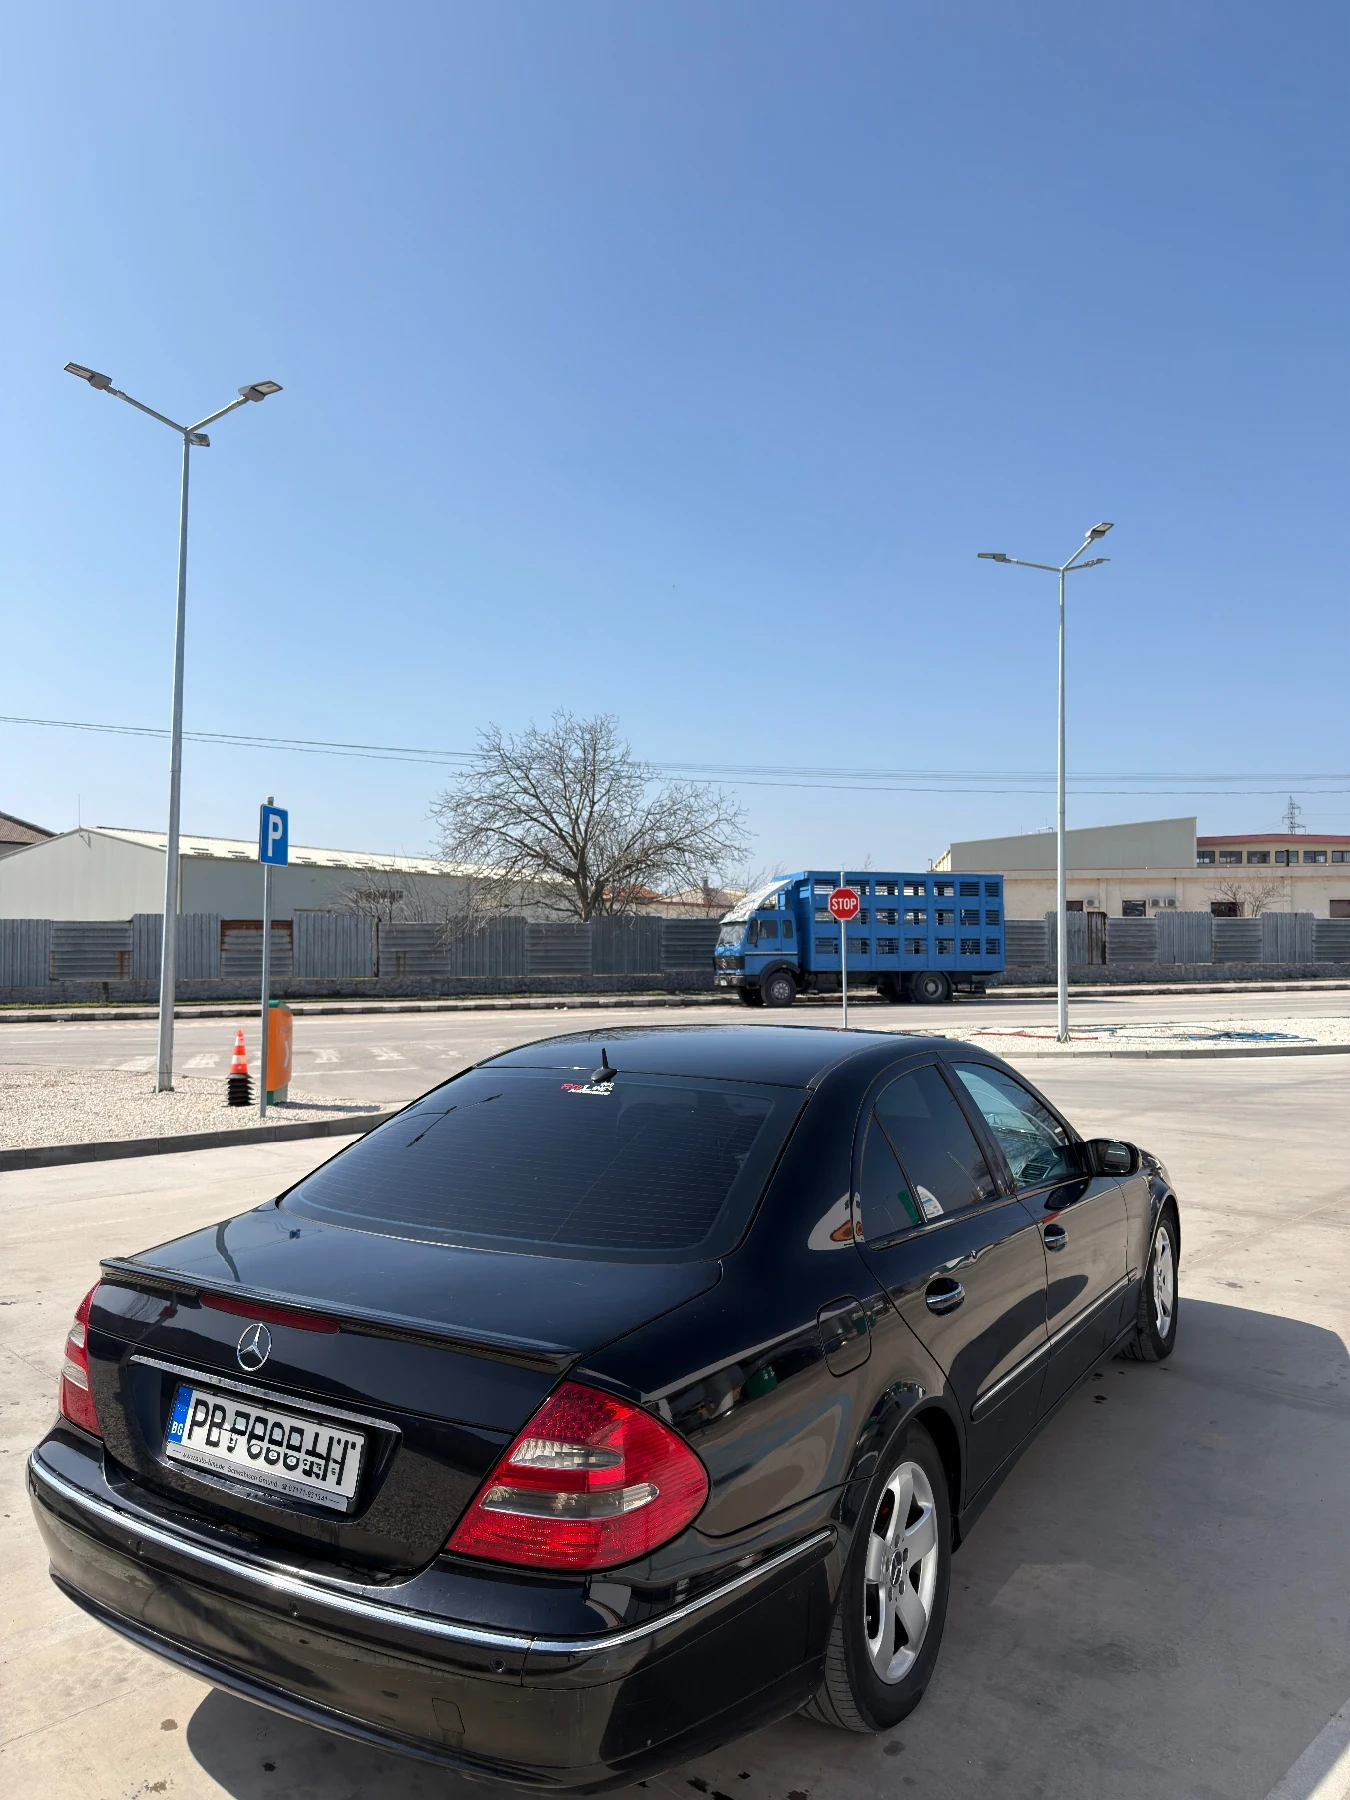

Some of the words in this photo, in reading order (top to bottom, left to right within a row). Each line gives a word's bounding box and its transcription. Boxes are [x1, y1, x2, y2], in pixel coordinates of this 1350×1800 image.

[267, 813, 283, 857] P
[831, 898, 857, 910] STOP
[171, 1421, 184, 1435] BG
